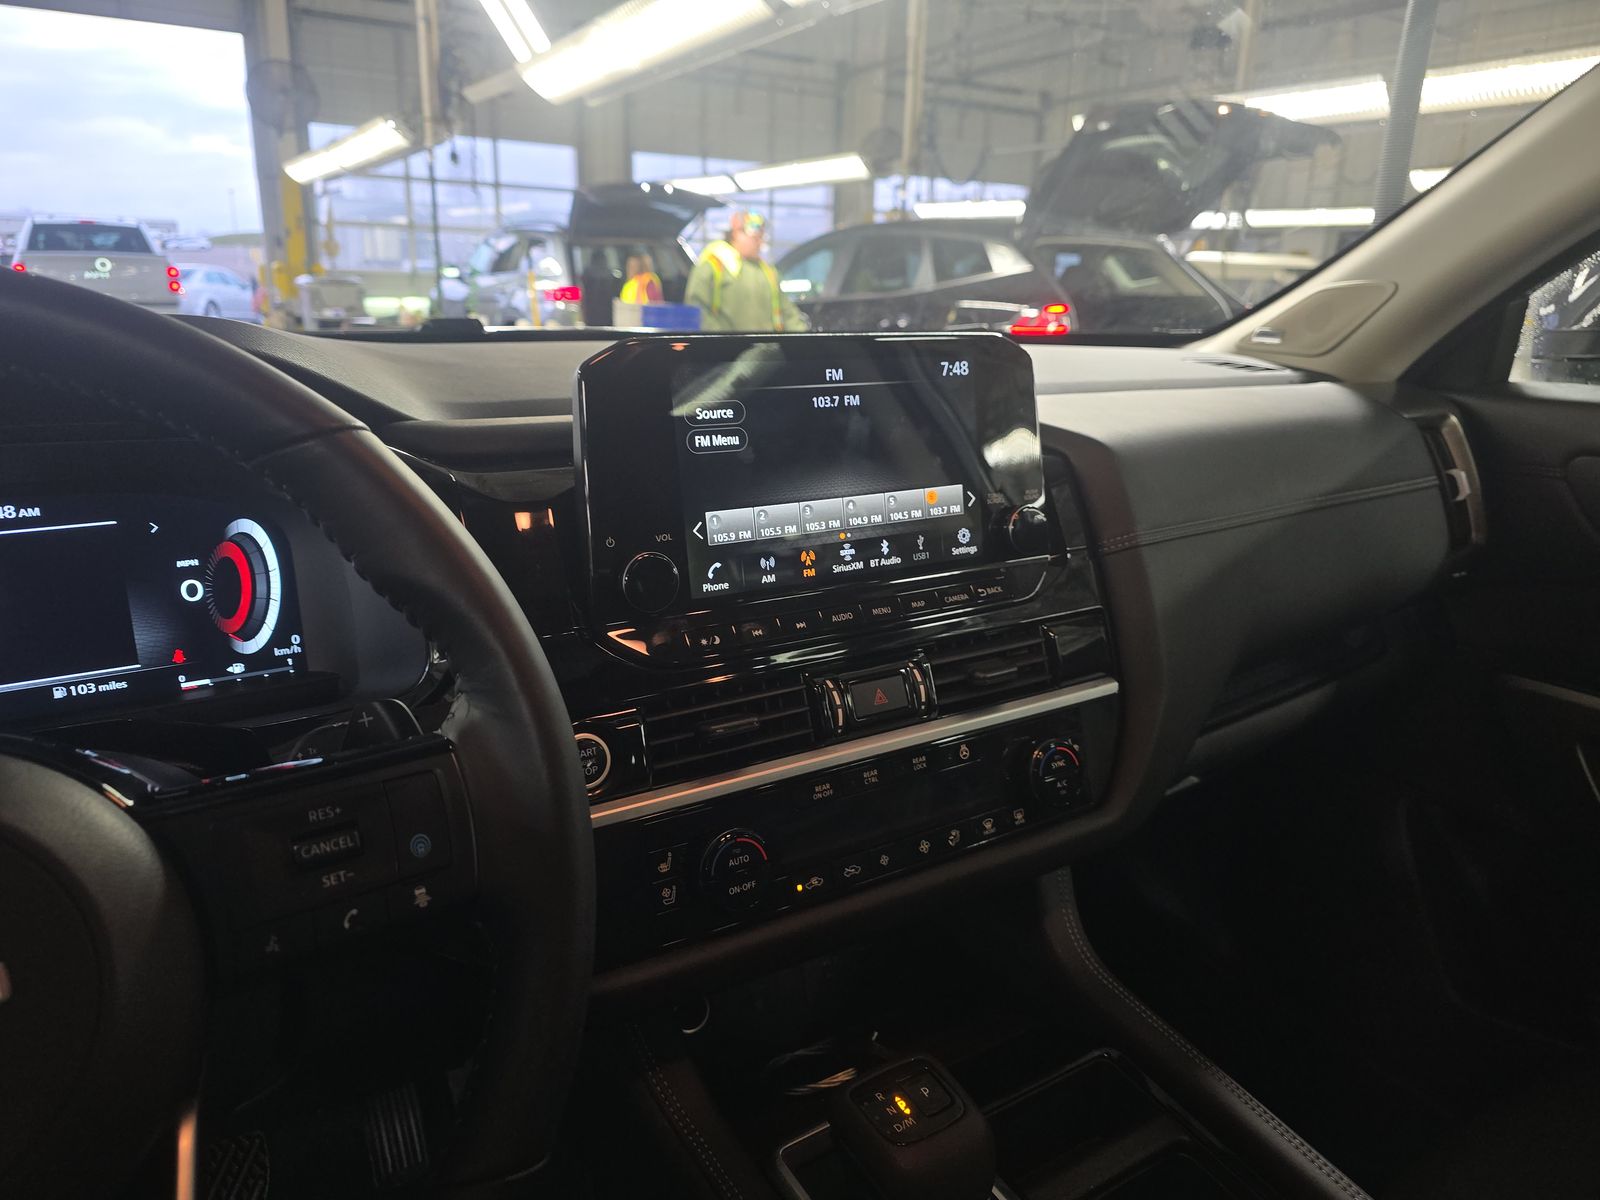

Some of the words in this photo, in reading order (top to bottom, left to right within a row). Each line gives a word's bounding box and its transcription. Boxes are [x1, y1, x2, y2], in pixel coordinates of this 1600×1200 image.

[825, 368, 843, 381] FM
[940, 361, 969, 377] 7:48
[812, 395, 839, 408] 103.7
[844, 394, 860, 406] FM
[695, 407, 734, 421] Source
[694, 435, 711, 448] FM
[712, 434, 740, 447] Menu
[847, 502, 854, 510] 4
[889, 498, 895, 506] 5
[18, 507, 41, 518] AM
[759, 512, 766, 520] 2
[805, 507, 811, 515] 3
[889, 511, 909, 521] 104.5
[910, 509, 922, 518] FM
[929, 506, 948, 516] 103.7
[949, 504, 961, 513] FM
[805, 521, 826, 531] 105.3
[828, 519, 841, 529] FM
[848, 516, 868, 526] 104.9
[871, 514, 882, 523] FM
[712, 532, 736, 543] 105.9
[738, 530, 752, 540] FM
[760, 526, 782, 537] 105.5
[784, 525, 797, 534] FM
[655, 533, 673, 543] VOL
[912, 551, 930, 561] USB1
[951, 544, 978, 556] Settings
[176, 558, 200, 568] MPH
[832, 561, 864, 573] SiriusXM
[869, 557, 883, 568] BT
[883, 555, 902, 566] Audio
[761, 574, 776, 584] AM
[802, 568, 816, 578] FM
[702, 581, 730, 593] Phone
[911, 600, 926, 609] MAP
[871, 606, 892, 616] MENU
[831, 612, 854, 623] AUDIO
[290, 634, 301, 645] 0
[273, 645, 302, 657] km/h
[69, 682, 97, 696] 103
[98, 680, 128, 693] miles
[580, 747, 598, 758] ART
[584, 765, 599, 776] OP
[308, 806, 343, 823] RES+
[300, 836, 354, 858] CANCEL
[728, 854, 751, 868] AUTO
[874, 1091, 886, 1102] R
[919, 1086, 930, 1097] P
[885, 1105, 897, 1116] N
[892, 1117, 917, 1134] D/M
